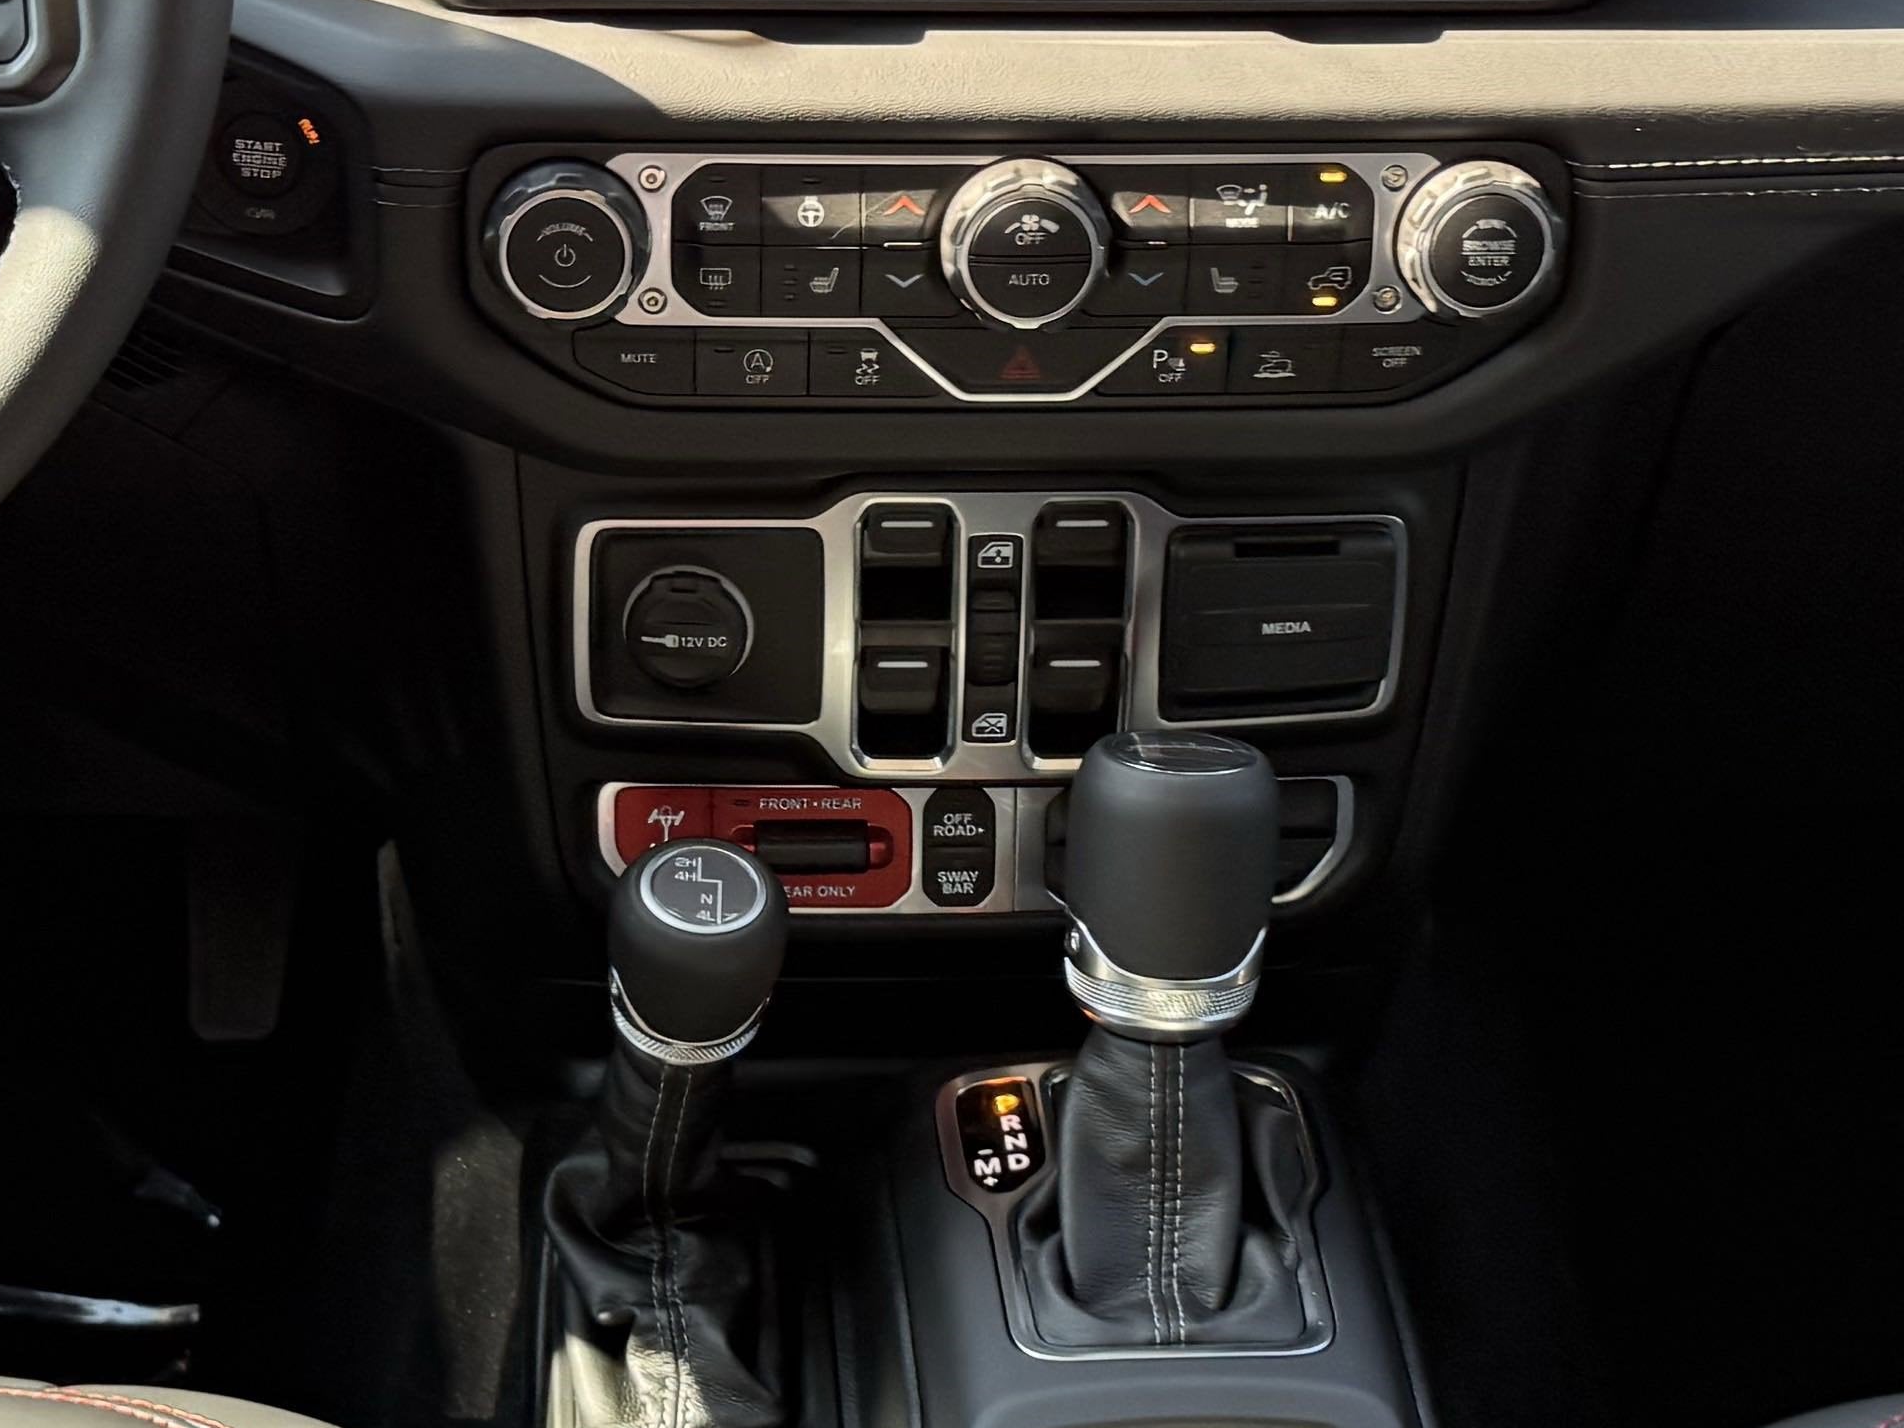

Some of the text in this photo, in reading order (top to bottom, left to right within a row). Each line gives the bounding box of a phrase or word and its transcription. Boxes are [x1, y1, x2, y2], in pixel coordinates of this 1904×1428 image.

[235, 139, 283, 152] START
[233, 153, 287, 167] ENGINE
[241, 168, 282, 179] STOP
[1315, 203, 1351, 219] A/C
[699, 222, 735, 233] FRONT
[1015, 233, 1046, 246] OFF
[1468, 256, 1510, 266] ENTER
[1009, 274, 1050, 286] AUTO
[621, 353, 657, 364] MUTE
[1382, 357, 1407, 368] OFF
[1262, 621, 1311, 635] MEDIA
[681, 637, 728, 648] 12V DC
[759, 798, 862, 810] FRONT REAR
[943, 814, 972, 825] OFF
[933, 825, 976, 837] ROAD
[674, 871, 696, 882] 4H
[938, 871, 978, 883] SWAY
[783, 885, 856, 898] EAR ONLY
[942, 882, 974, 894] BAR
[700, 893, 713, 905] N
[1000, 1114, 1023, 1132] R
[1004, 1132, 1028, 1151] N
[974, 1157, 1002, 1177] M
[1007, 1153, 1031, 1171] D
